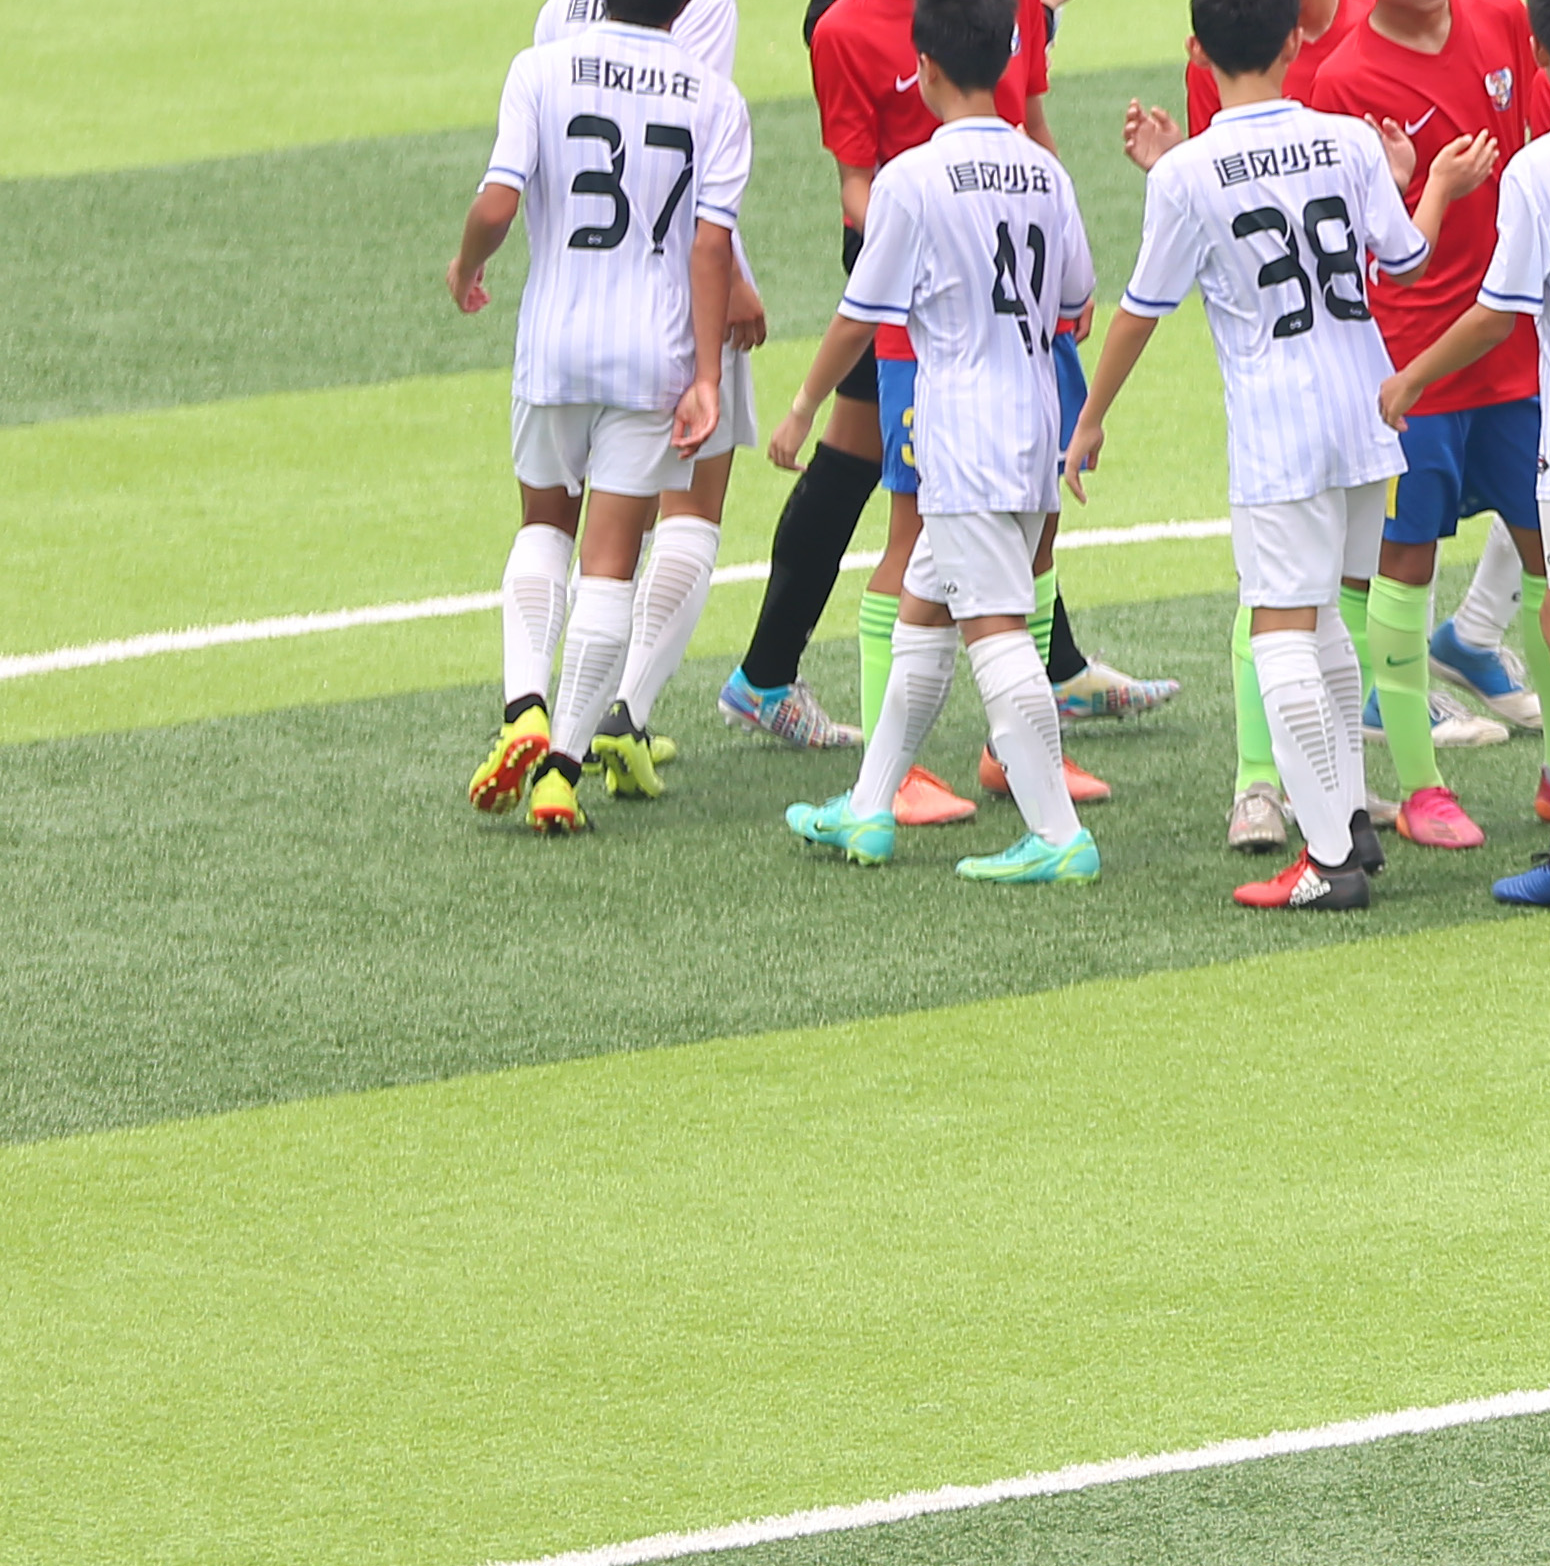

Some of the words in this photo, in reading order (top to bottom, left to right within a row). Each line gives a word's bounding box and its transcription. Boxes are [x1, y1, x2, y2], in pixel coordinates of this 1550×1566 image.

[571, 56, 700, 104] 追风少年
[566, 114, 693, 254] 37
[947, 161, 1052, 194] 追风少年
[1213, 139, 1341, 189] 追风少年
[991, 221, 1050, 356] 41
[1231, 196, 1372, 339] 38
